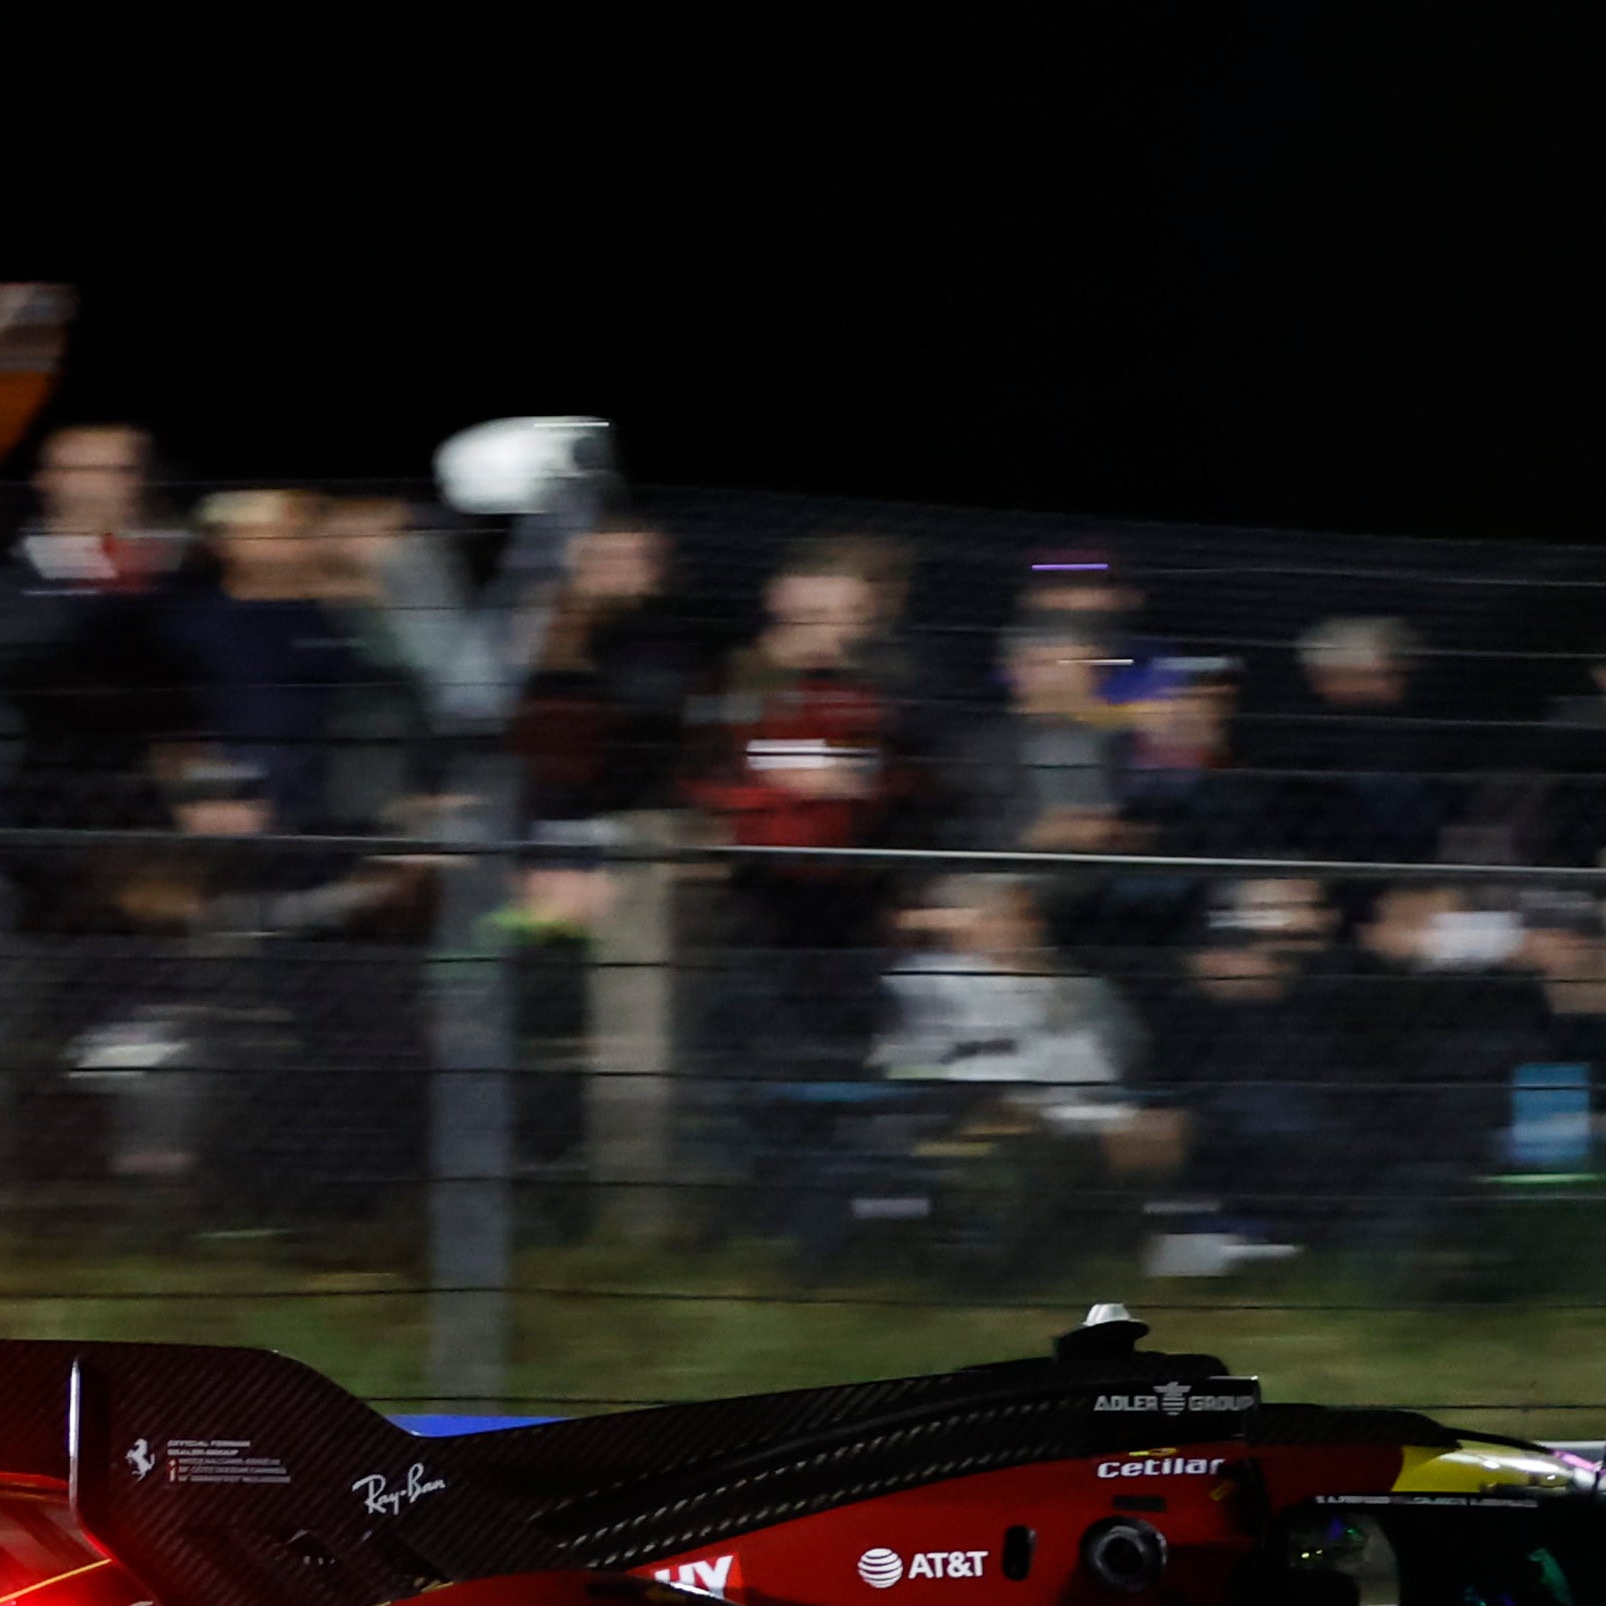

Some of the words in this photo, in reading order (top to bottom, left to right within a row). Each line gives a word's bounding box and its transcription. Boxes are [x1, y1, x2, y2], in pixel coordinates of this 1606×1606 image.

[1093, 1395, 1159, 1411] ADLER
[1188, 1395, 1255, 1411] GROUP
[351, 1462, 447, 1515] Ray-Ban
[908, 1550, 989, 1579] AT&T
